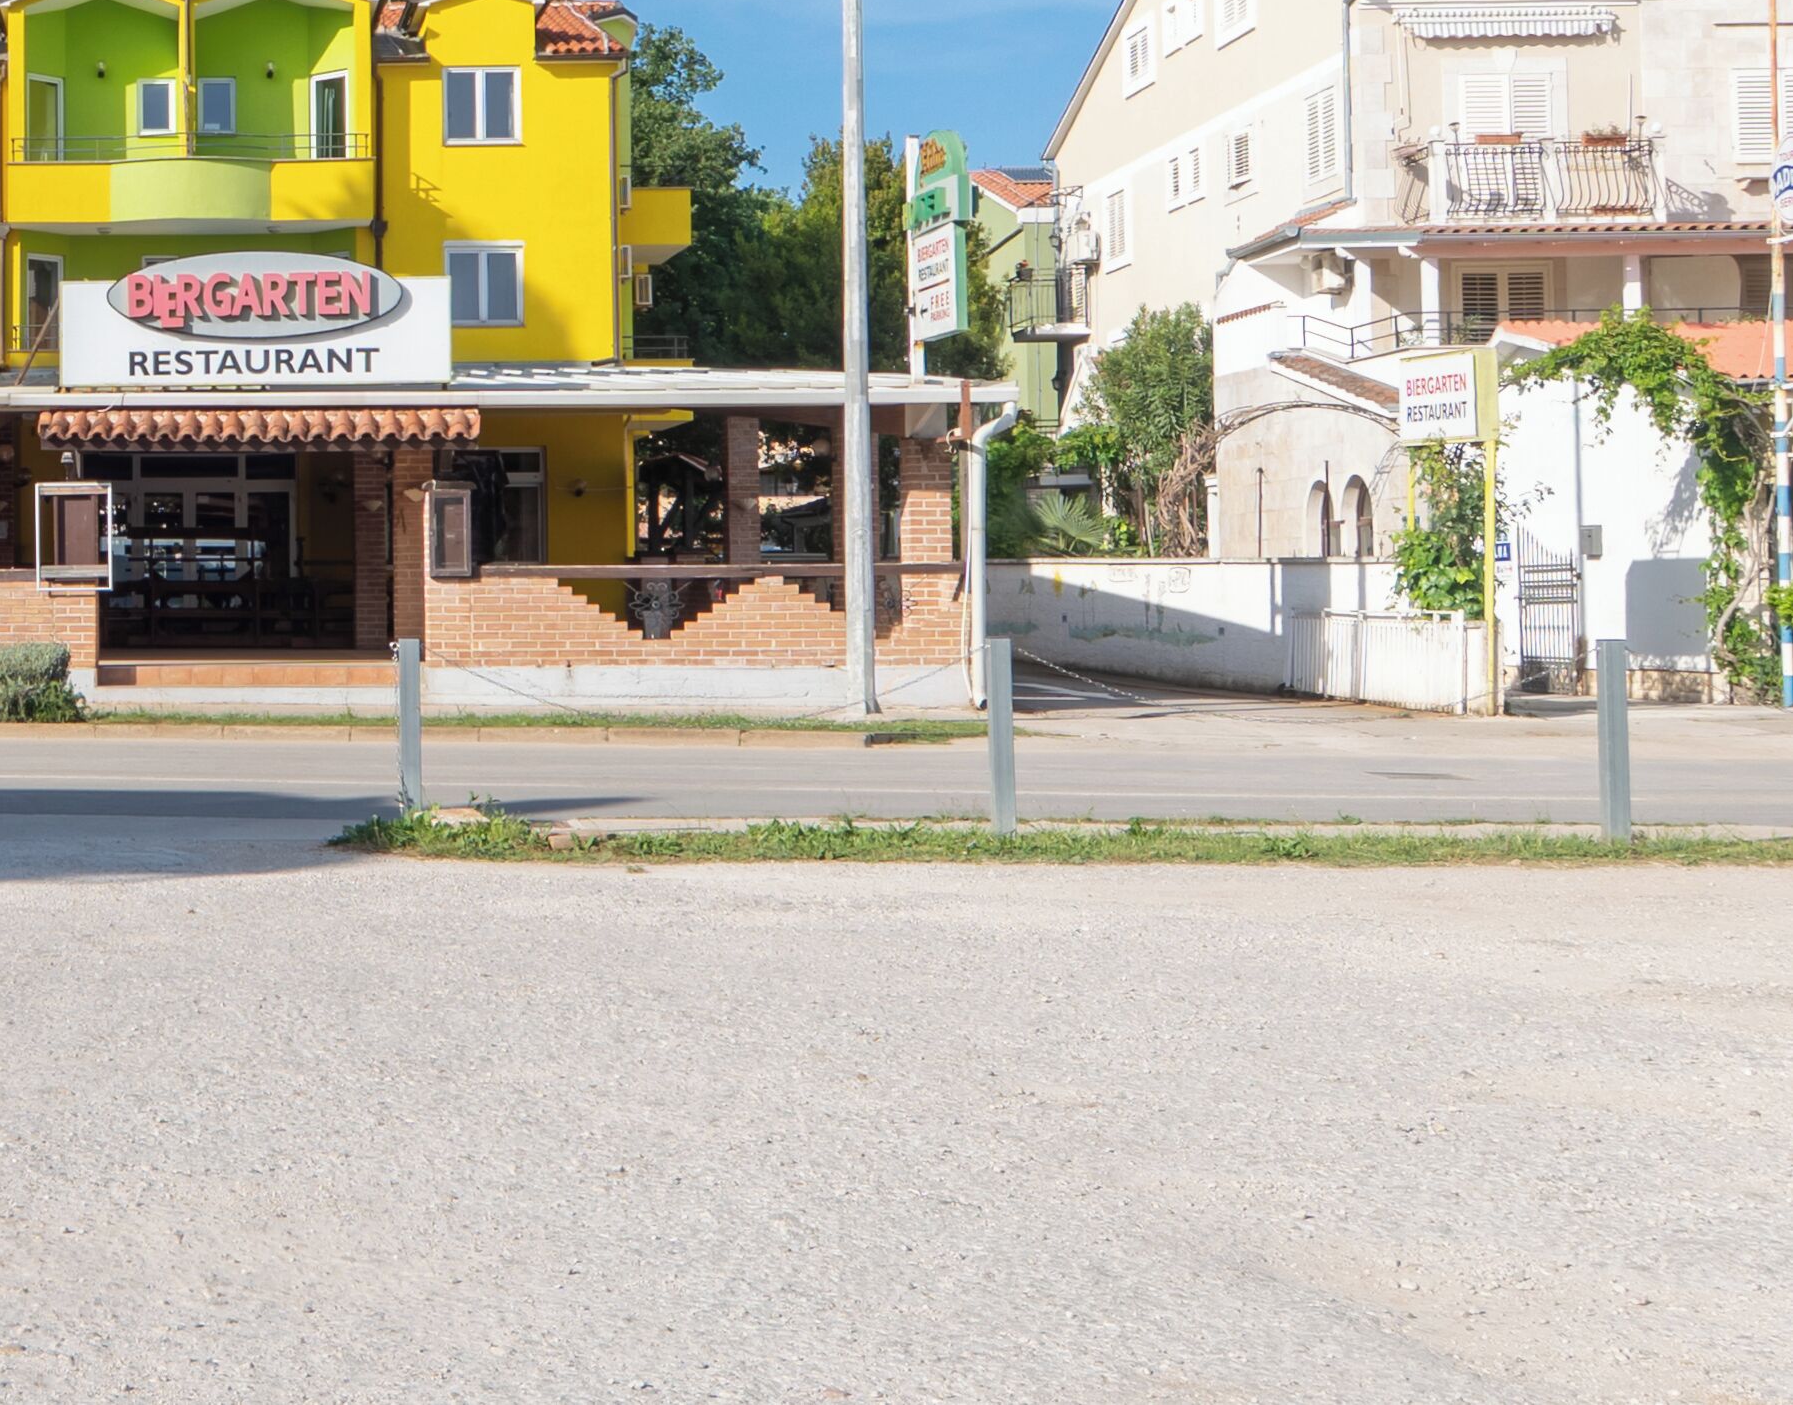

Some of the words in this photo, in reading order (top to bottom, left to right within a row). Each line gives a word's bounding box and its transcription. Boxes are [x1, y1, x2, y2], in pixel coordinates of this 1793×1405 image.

[126, 271, 374, 328] BIERGARTEN
[930, 290, 950, 309] FREE
[128, 347, 381, 377] RESTAURANT
[1406, 373, 1467, 397] BIERGARTEN
[1407, 401, 1467, 423] RESTAURANT
